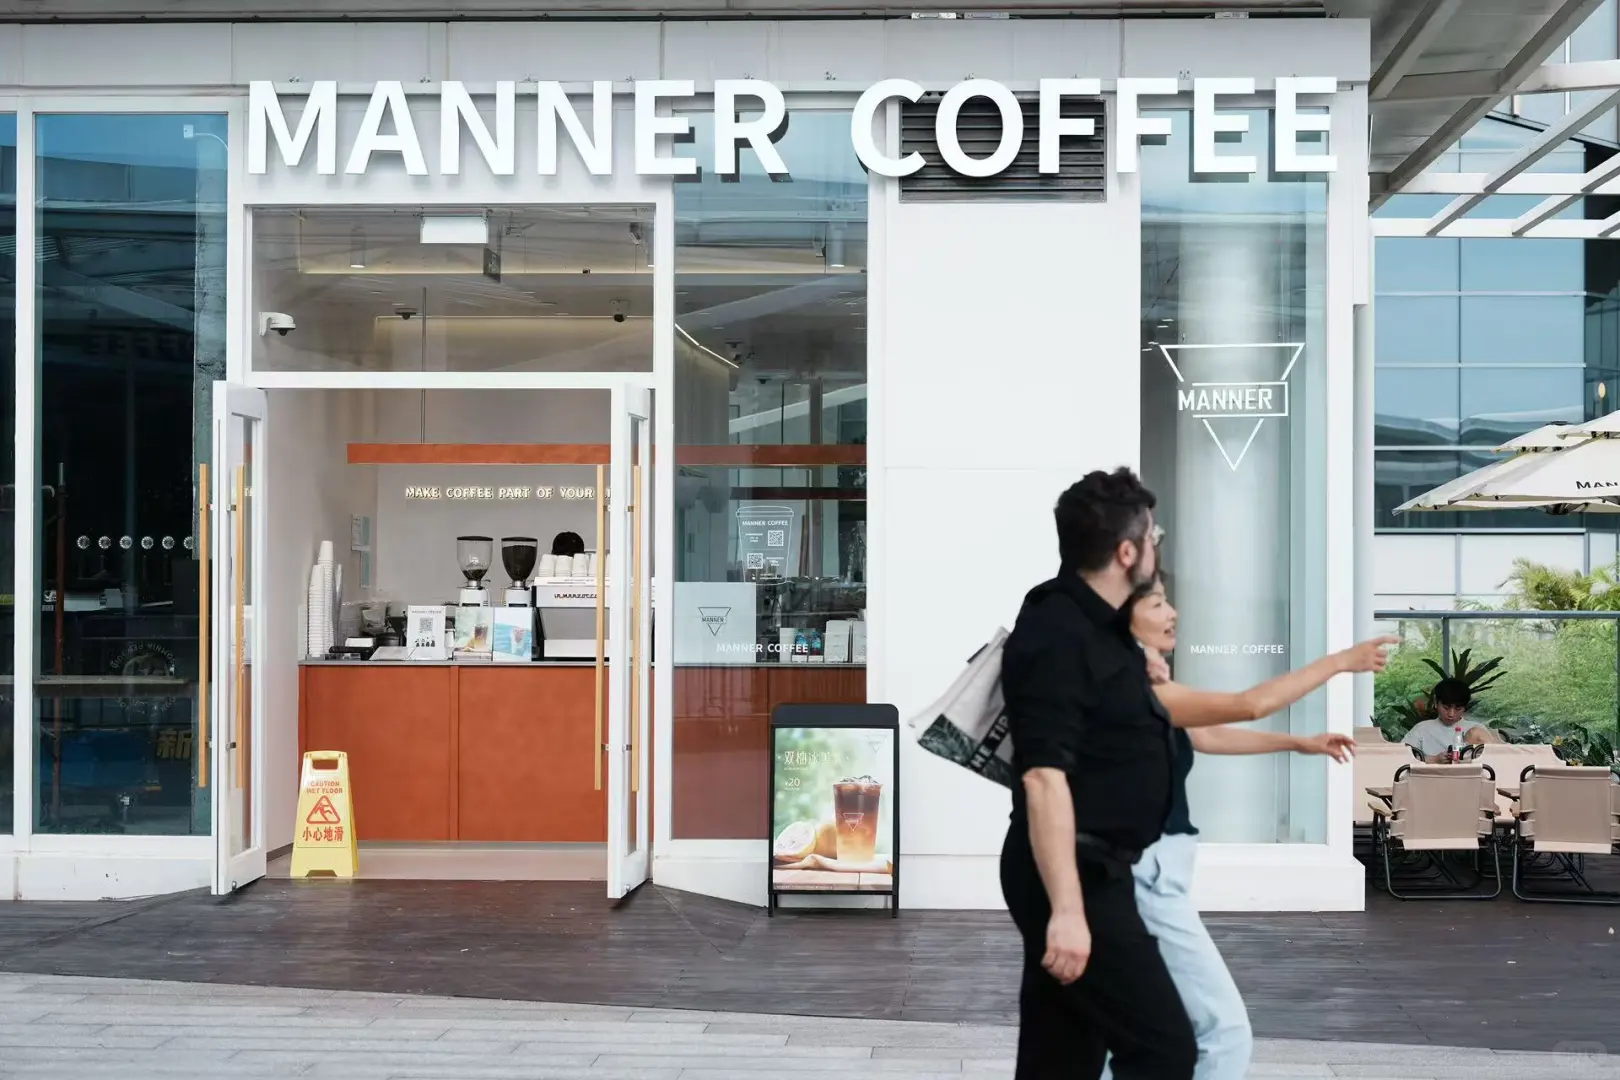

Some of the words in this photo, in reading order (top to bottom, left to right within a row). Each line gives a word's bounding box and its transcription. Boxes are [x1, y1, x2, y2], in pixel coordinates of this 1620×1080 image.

[248, 79, 789, 175] MANNER
[851, 76, 1338, 178] COFFEE
[1178, 388, 1272, 411] MANNER
[405, 486, 440, 499] MAKE
[446, 486, 494, 499] COFFEE
[499, 486, 531, 499] PART
[536, 486, 555, 499] OF
[560, 486, 595, 499] YOUR
[716, 643, 763, 654] MANNER
[767, 643, 809, 654] COFFEE
[1190, 644, 1238, 654] MANNER
[1242, 644, 1285, 654] COFFEE
[302, 826, 344, 842] 小心地滑
